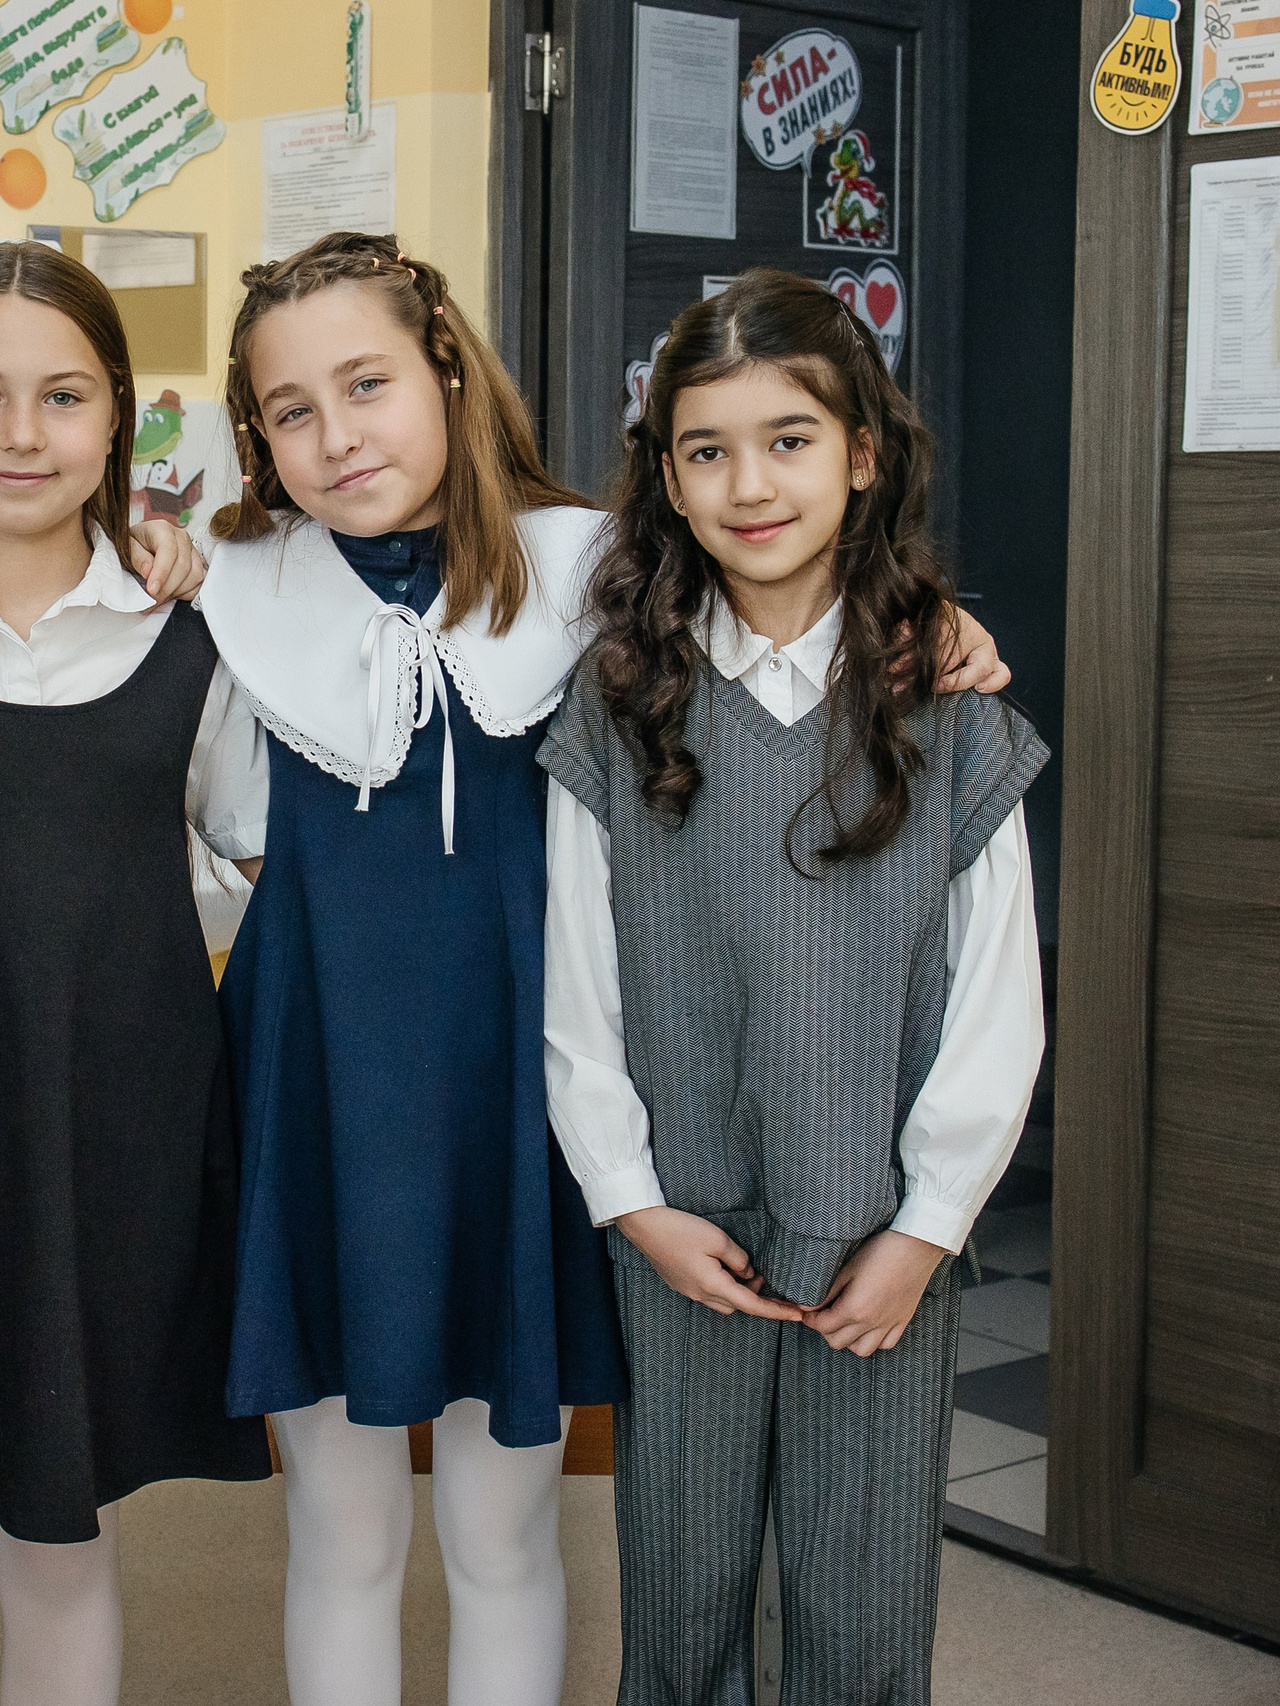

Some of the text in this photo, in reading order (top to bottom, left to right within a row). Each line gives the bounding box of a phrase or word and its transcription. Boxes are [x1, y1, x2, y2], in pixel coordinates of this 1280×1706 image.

[1119, 42, 1167, 76] БУДЬ
[1098, 71, 1172, 100] АКТИВНЫМ!
[762, 68, 856, 157] В ЗНАНИЯХ!
